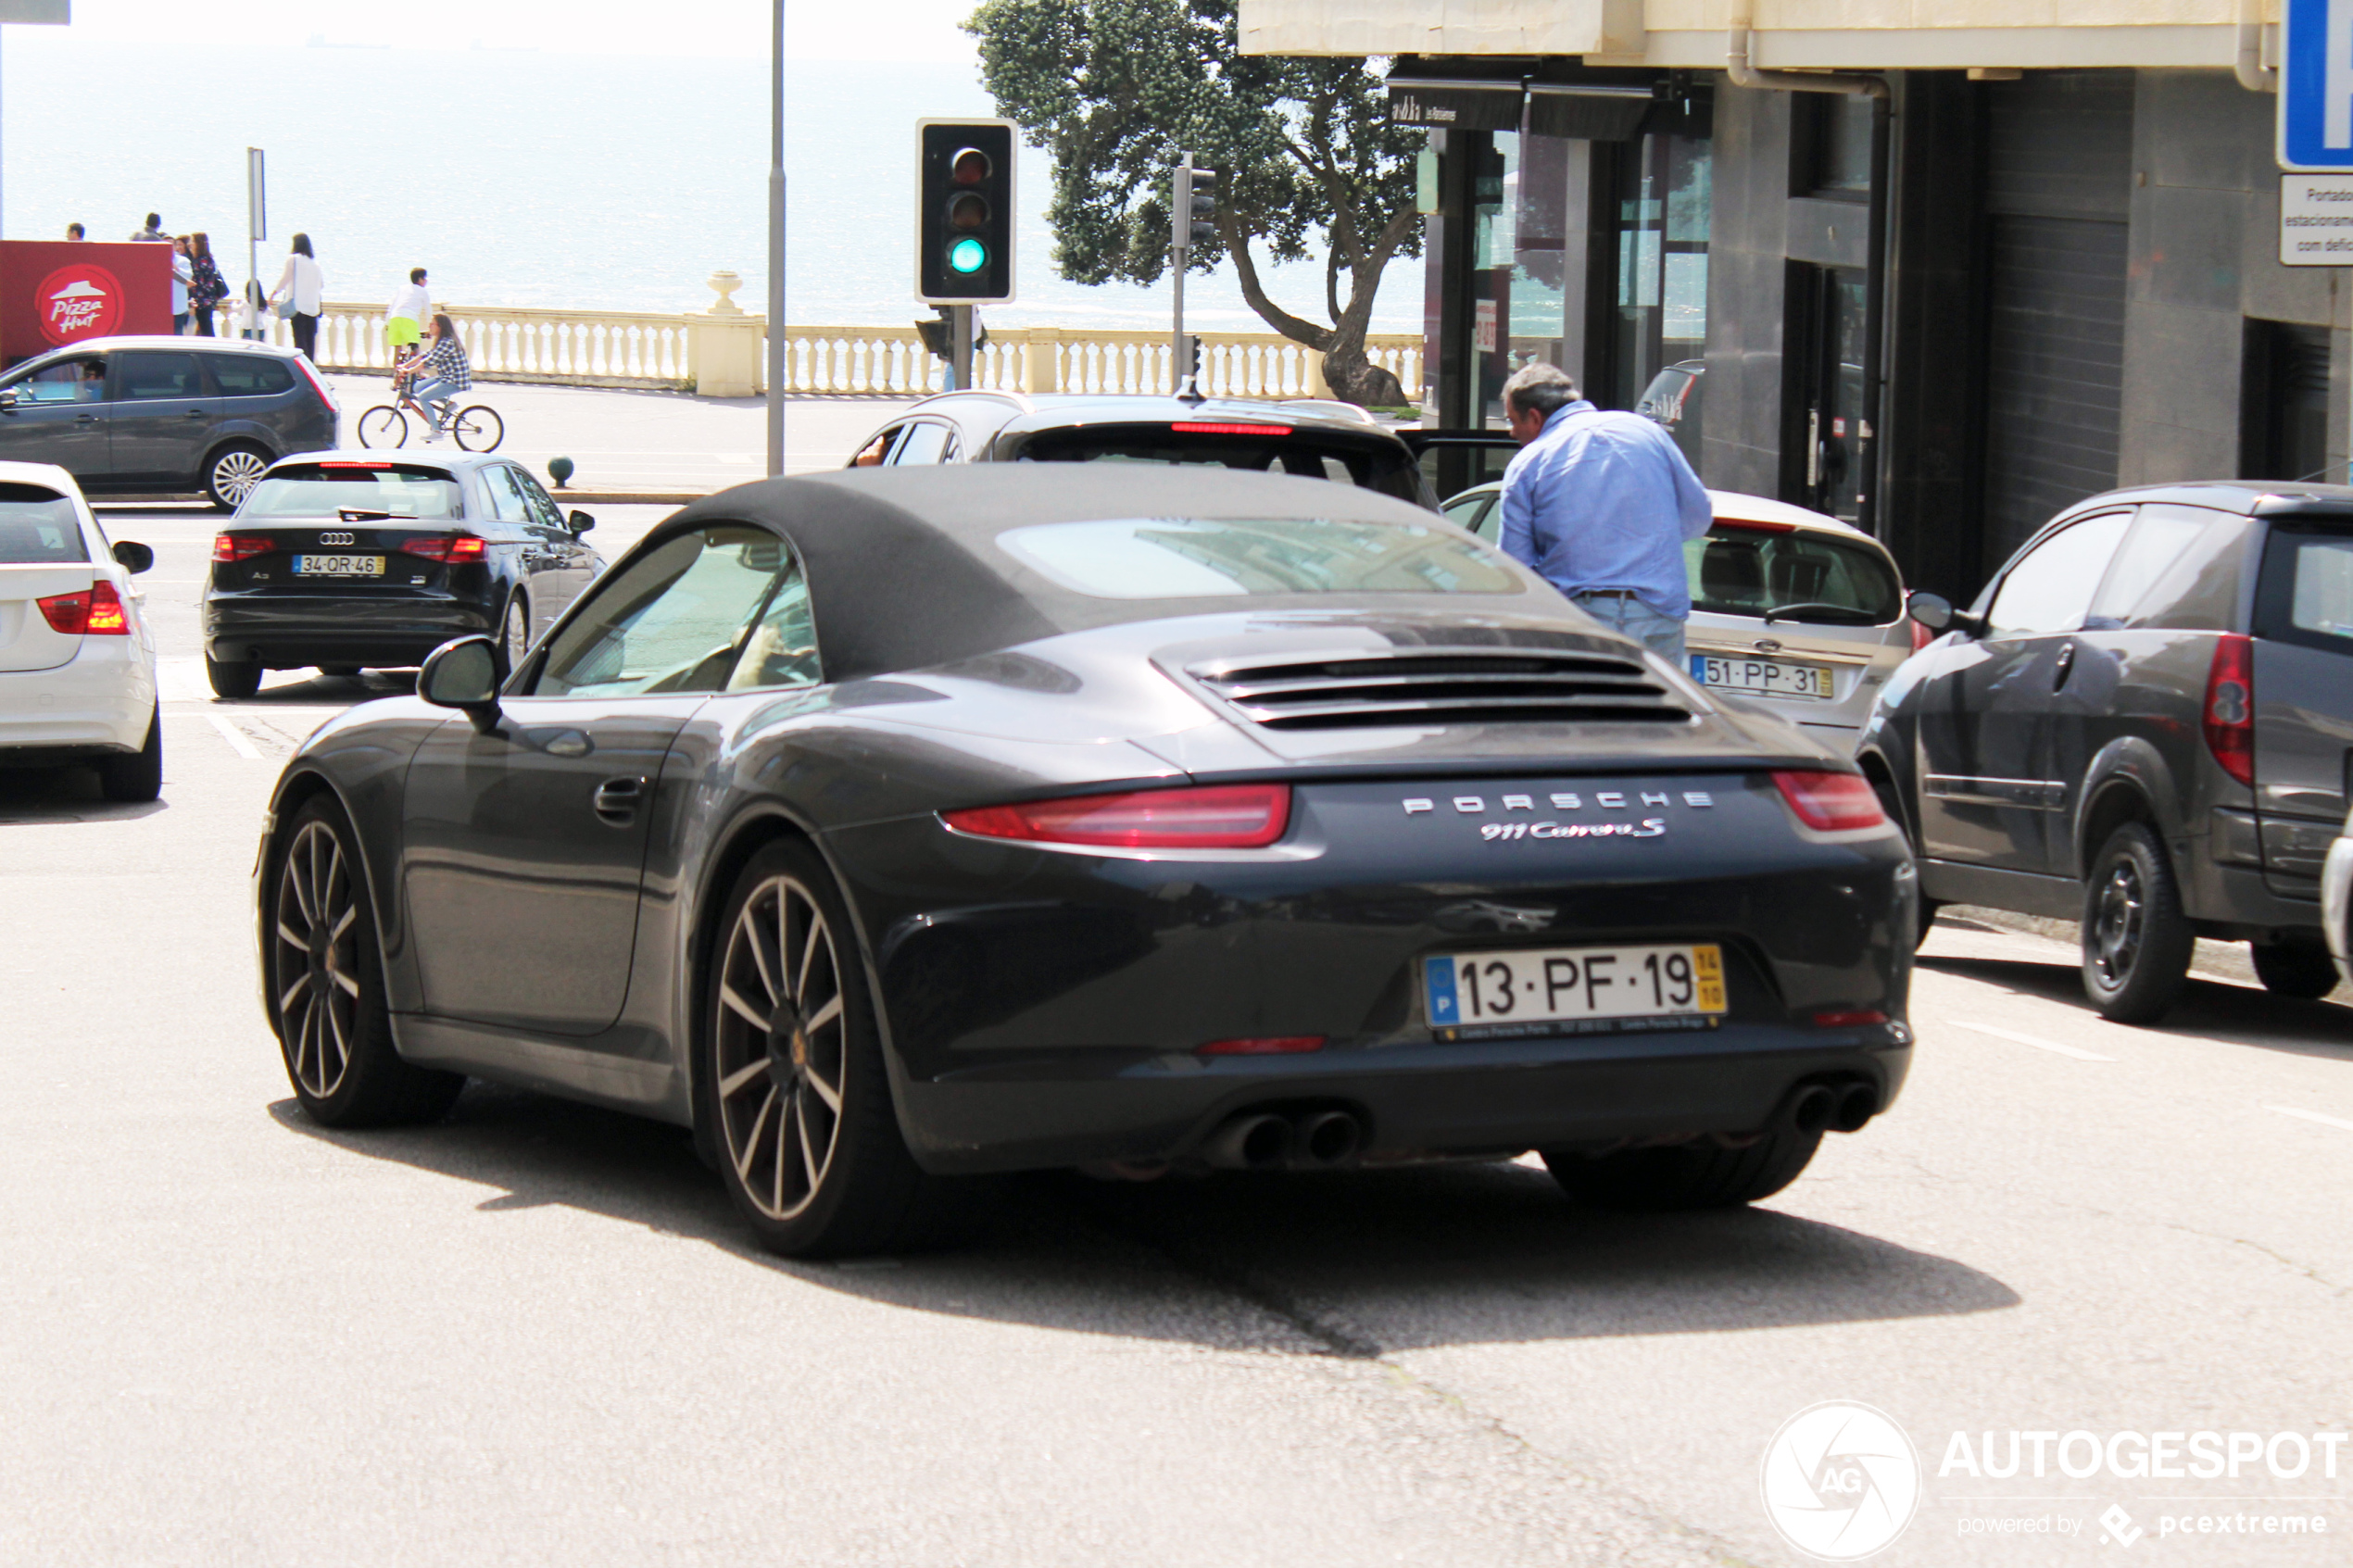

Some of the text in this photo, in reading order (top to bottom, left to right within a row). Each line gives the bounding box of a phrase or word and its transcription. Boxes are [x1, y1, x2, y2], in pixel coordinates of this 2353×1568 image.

[2297, 242, 2321, 252] com
[51, 297, 104, 321] Pizza
[59, 312, 101, 333] Hut
[1403, 792, 1714, 815] PORSCHE
[1481, 818, 1665, 841] 911 Carrera S
[1698, 952, 1718, 971] 14
[1438, 997, 1452, 1013] P
[1701, 985, 1722, 1005] 10
